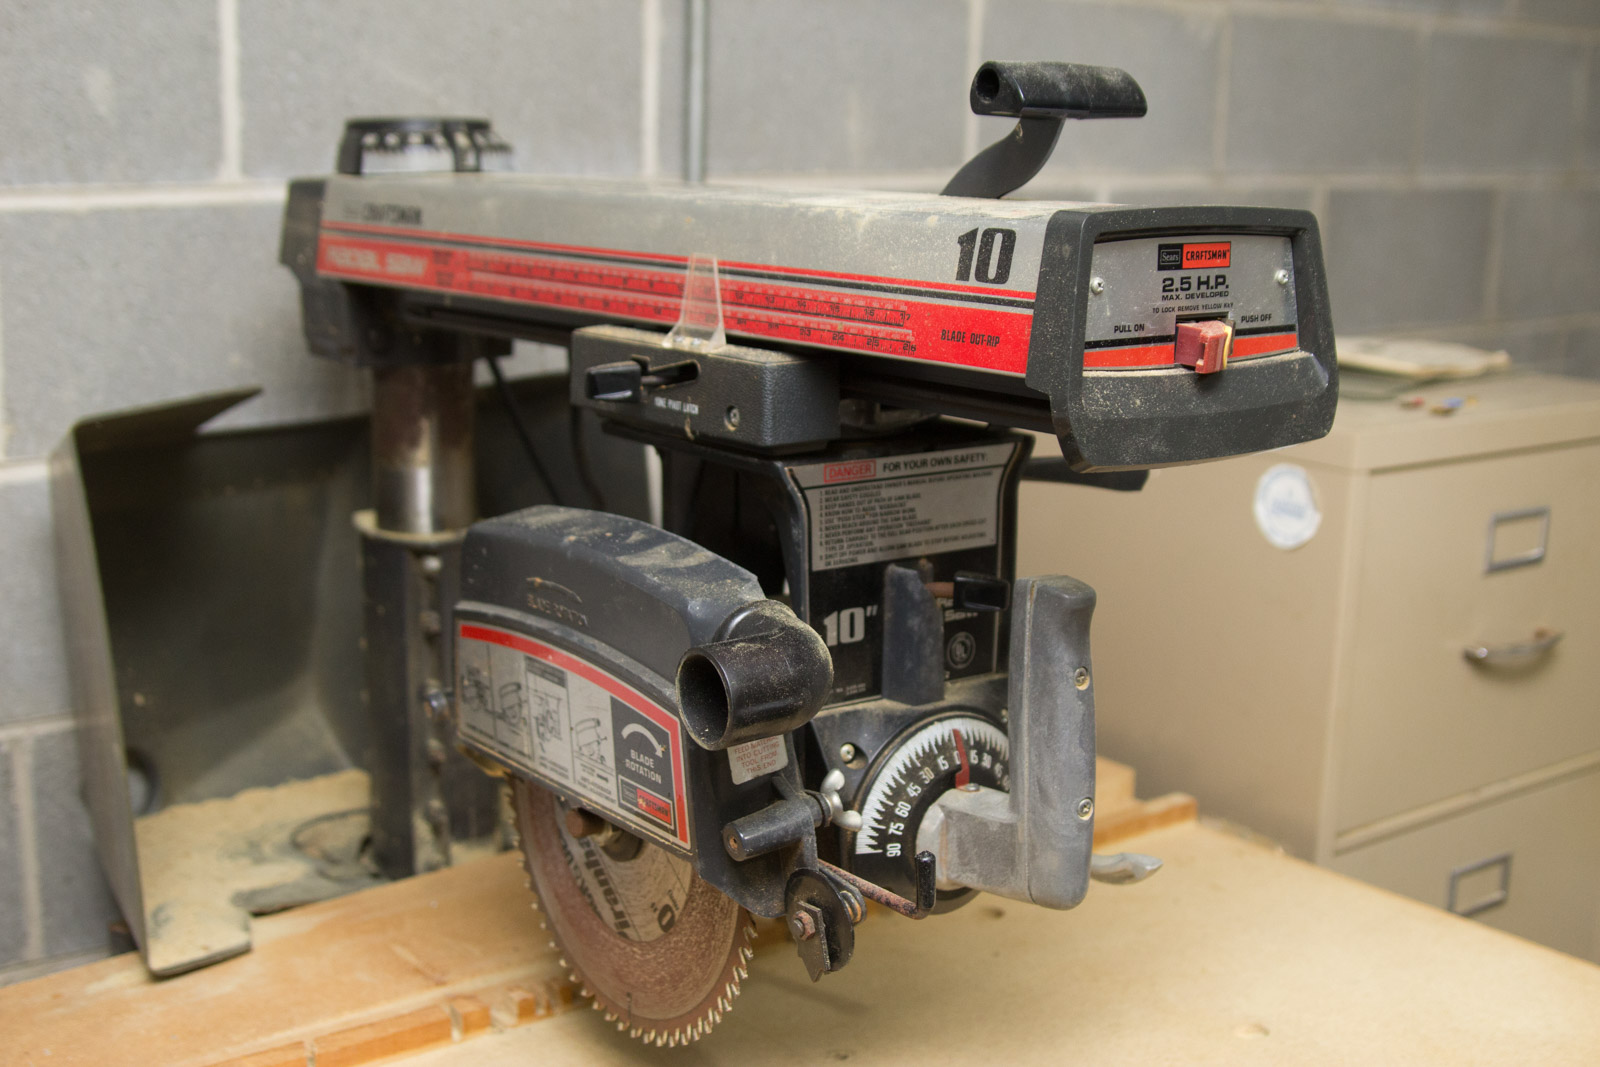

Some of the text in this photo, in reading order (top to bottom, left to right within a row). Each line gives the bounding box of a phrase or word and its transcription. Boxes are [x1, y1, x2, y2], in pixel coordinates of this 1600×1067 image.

[956, 227, 1016, 285] 10
[1162, 249, 1228, 263] Sears CRAFTSMAN
[1162, 274, 1229, 293] 2.5 H.P.
[1185, 290, 1229, 300] DEVELOPED
[1177, 304, 1199, 312] REMOVE
[1201, 302, 1223, 310] YELLOW
[1223, 301, 1234, 309] KEY
[1241, 313, 1272, 323] PUSH OFF
[1114, 323, 1145, 334] PULL ON
[832, 333, 845, 342] 24
[866, 338, 880, 347] 25
[902, 343, 917, 352] 26
[941, 329, 1000, 348] BLADE OUT-RIP
[829, 463, 872, 479] DANGER
[883, 461, 903, 473] FOR
[903, 459, 929, 471] YOUR
[930, 456, 952, 467] OWN
[823, 605, 878, 647] 10"
[630, 749, 655, 768] BLADE
[936, 755, 949, 771] 15
[625, 759, 662, 784] ROTATION
[919, 766, 935, 784] 30
[906, 782, 922, 797] 45
[894, 801, 911, 818] 60
[888, 822, 905, 835] 75
[886, 842, 901, 857] 90
